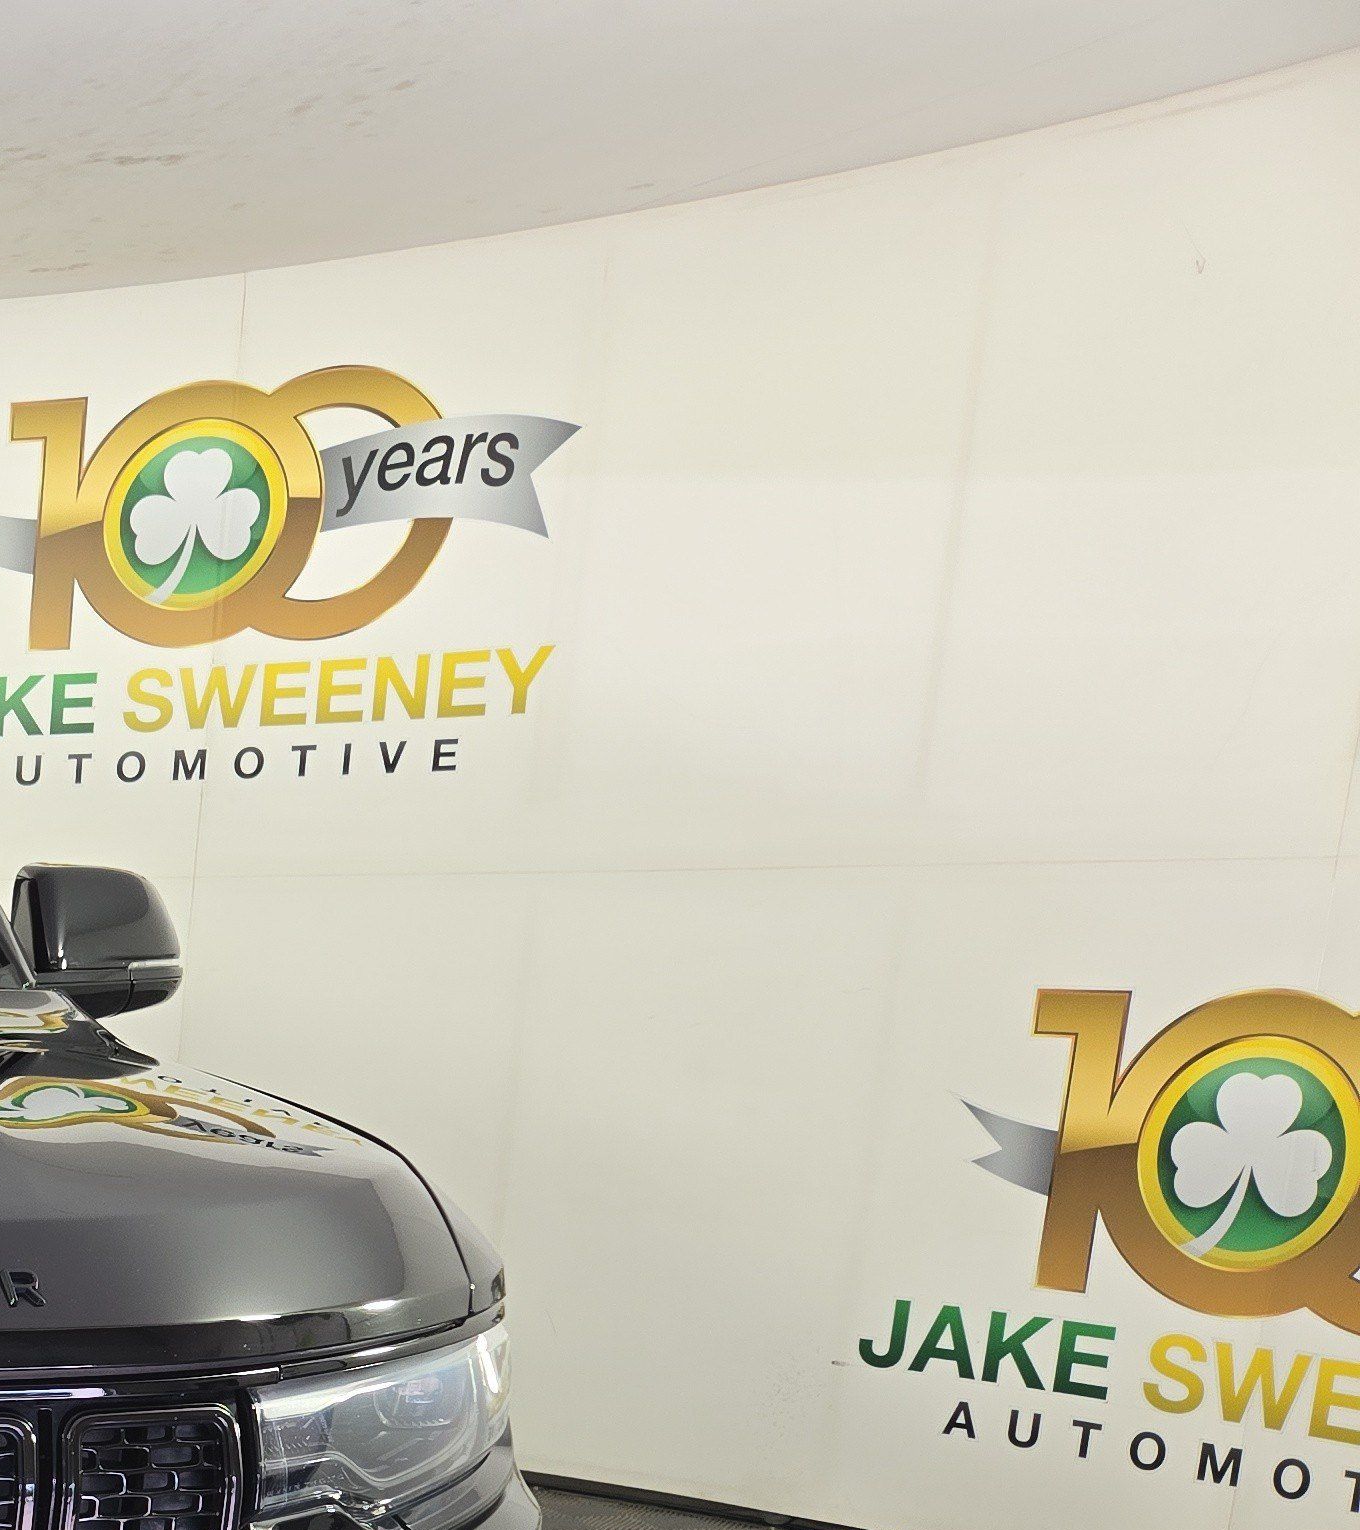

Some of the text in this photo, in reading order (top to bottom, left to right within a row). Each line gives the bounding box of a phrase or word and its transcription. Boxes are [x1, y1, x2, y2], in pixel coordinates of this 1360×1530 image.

[334, 430, 520, 519] years
[121, 644, 556, 734] SWEENEY
[858, 1299, 1117, 1401] JAKE
